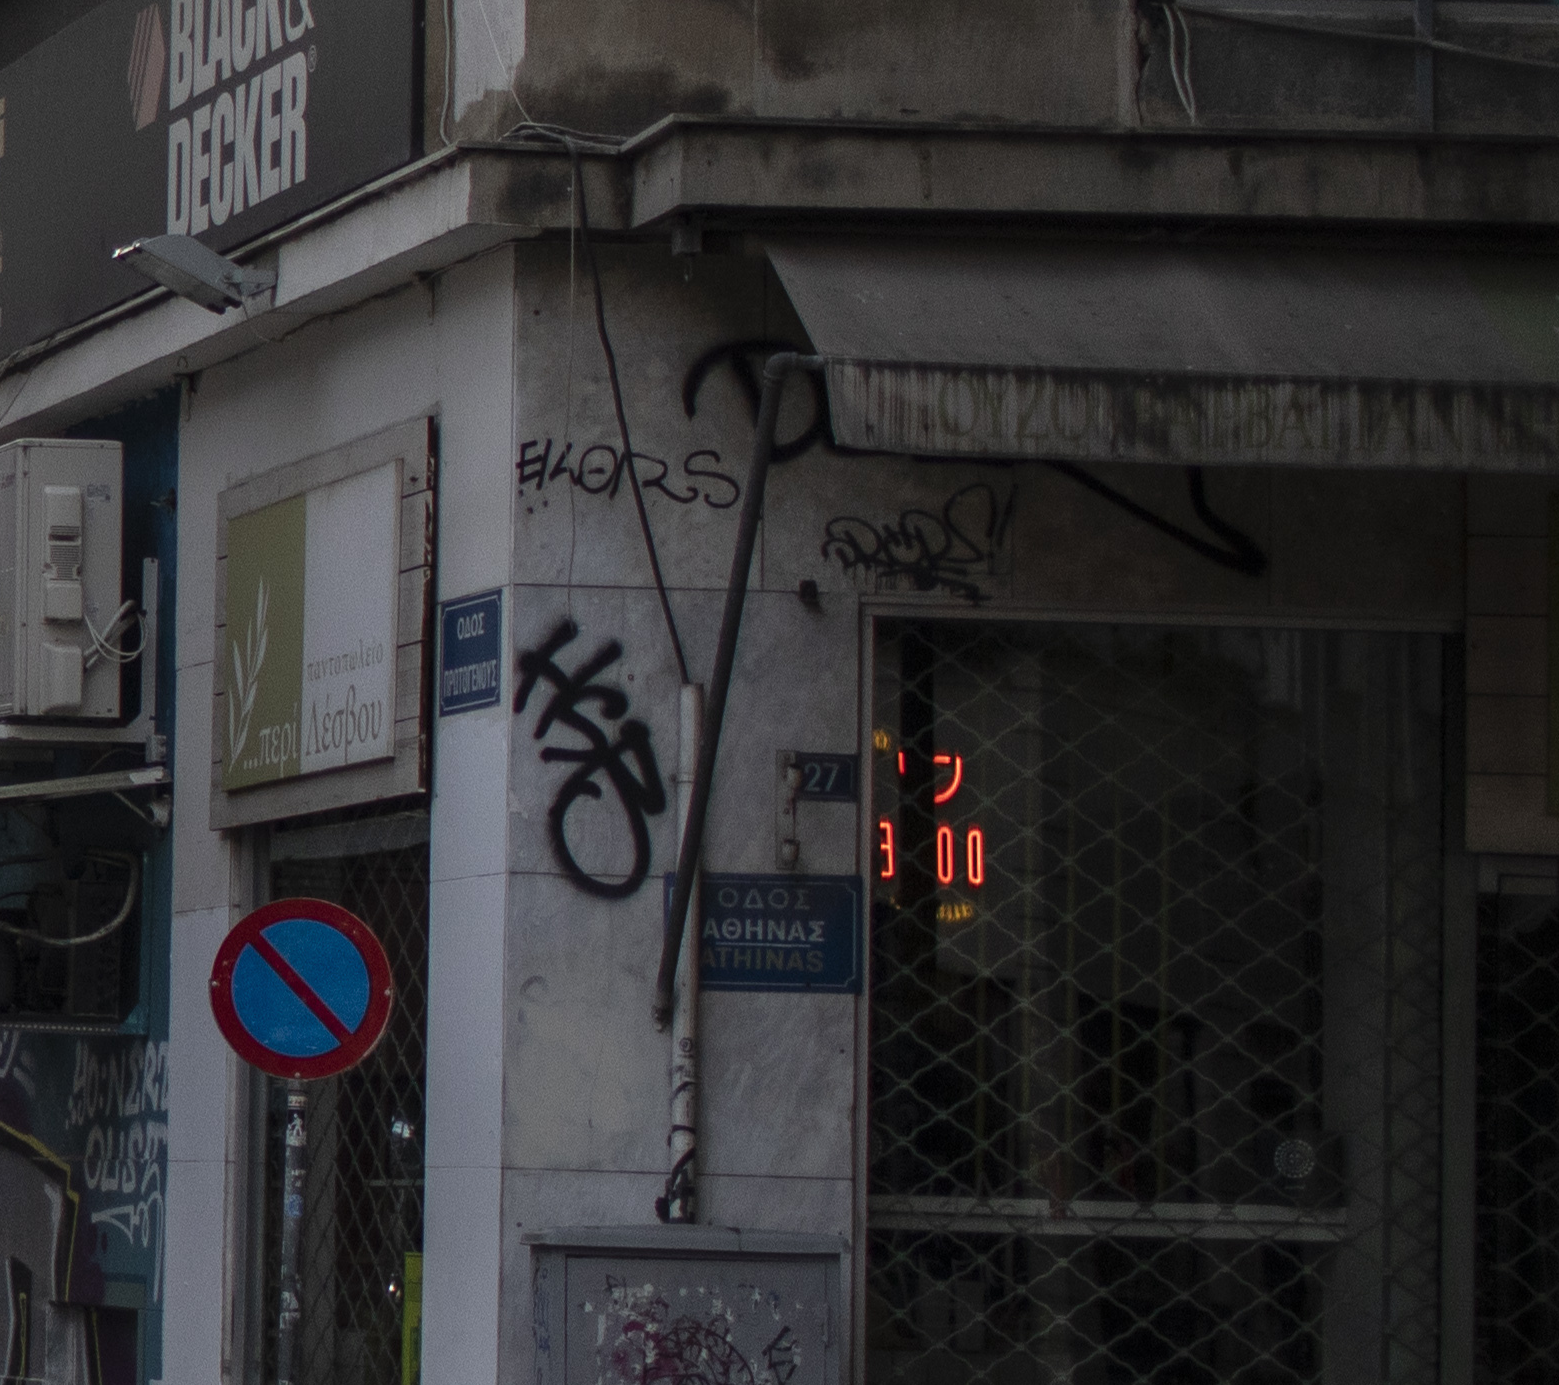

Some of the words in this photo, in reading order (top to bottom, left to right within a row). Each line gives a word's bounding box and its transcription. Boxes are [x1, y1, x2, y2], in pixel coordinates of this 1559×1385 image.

[167, 51, 307, 238] DECKER
[457, 611, 485, 640] ΟΔΟΣ
[305, 686, 383, 765] Λέσβου
[802, 762, 840, 793] 27
[717, 887, 811, 911] ΟΔΟΣ
[701, 917, 826, 943] ΑΘΗΝΑΣ
[700, 947, 825, 974] ATHINAS
